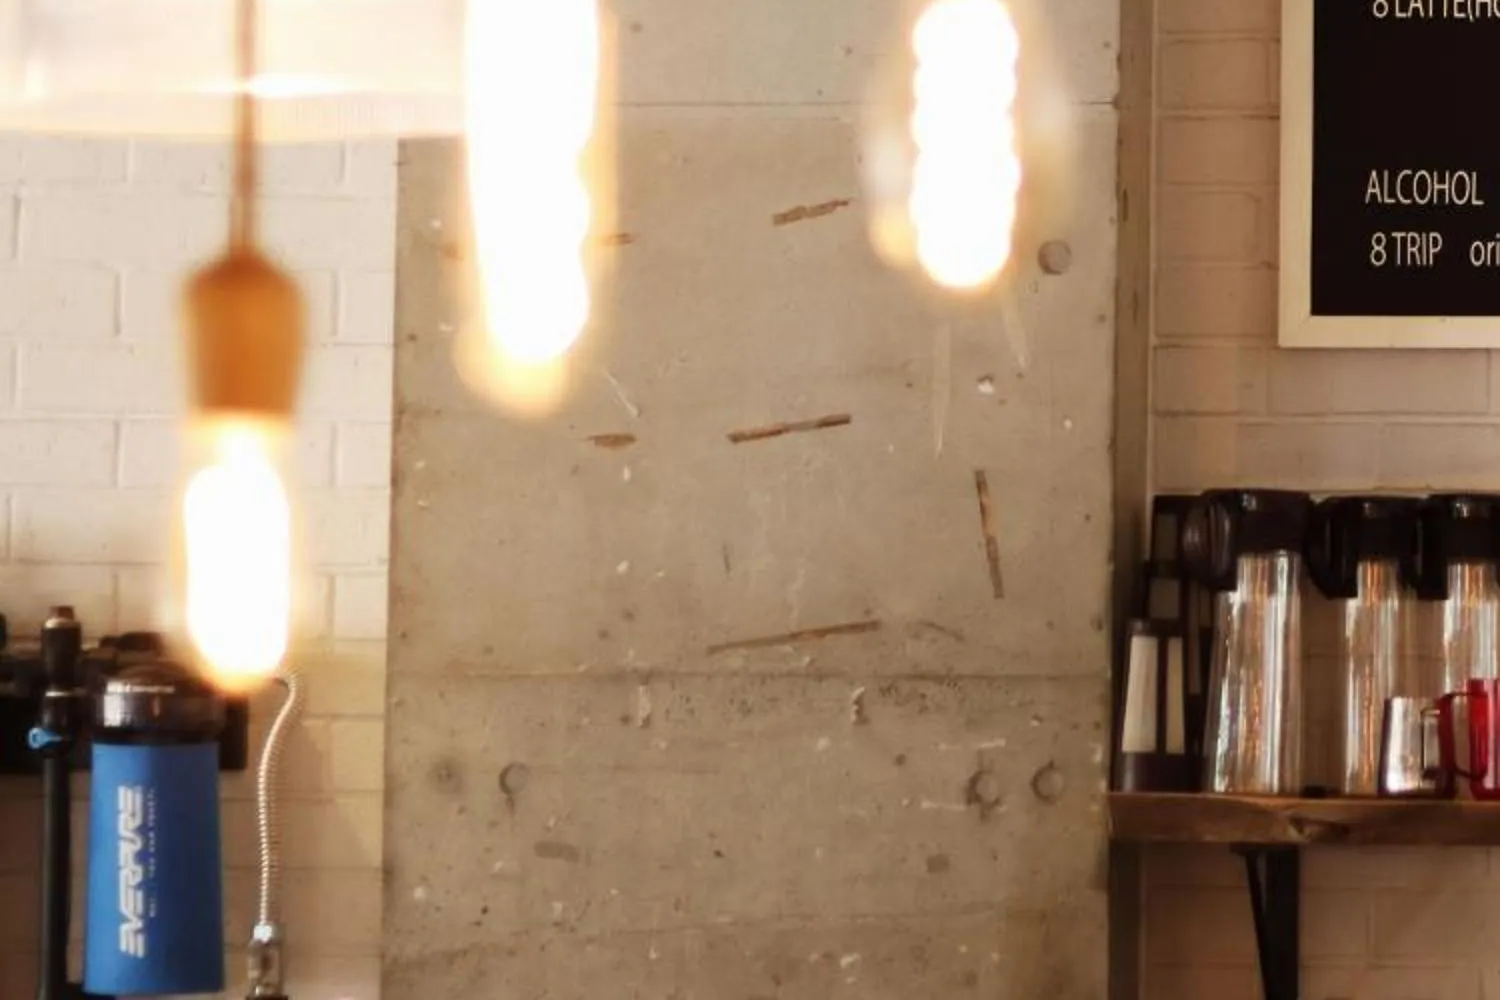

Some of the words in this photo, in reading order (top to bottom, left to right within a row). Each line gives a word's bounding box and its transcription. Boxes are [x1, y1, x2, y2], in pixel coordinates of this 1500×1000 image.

[1364, 169, 1485, 206] ALCOHOL
[1370, 234, 1386, 266] 8
[1392, 231, 1444, 267] TRIP
[119, 785, 146, 958] EVERPURE
